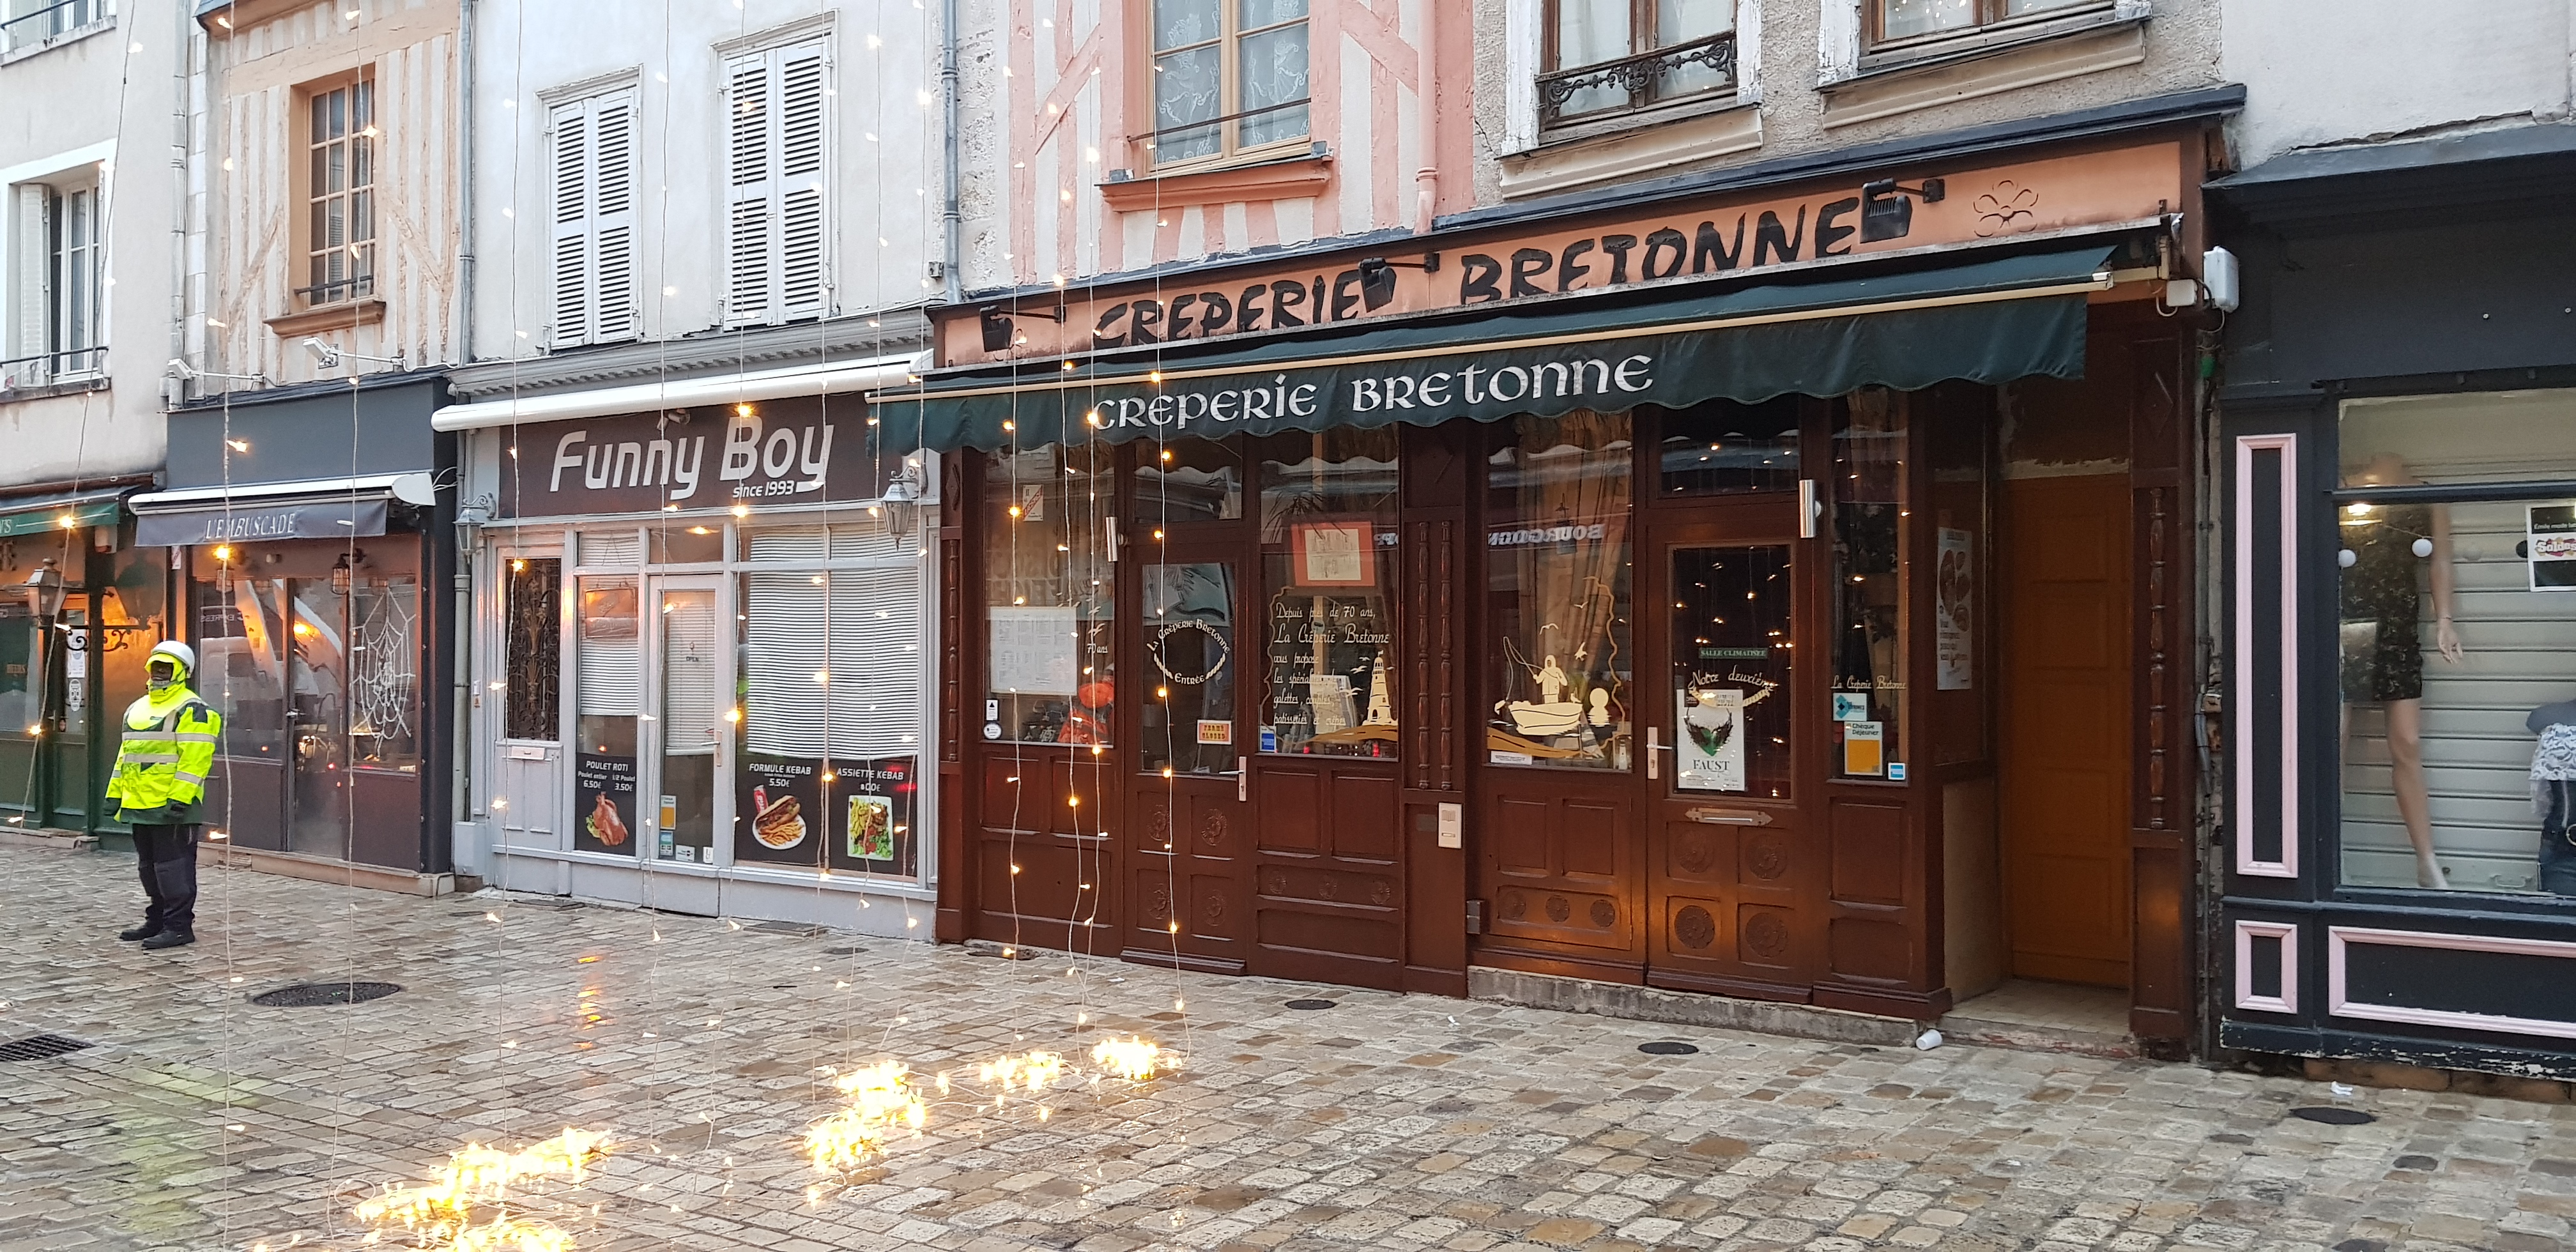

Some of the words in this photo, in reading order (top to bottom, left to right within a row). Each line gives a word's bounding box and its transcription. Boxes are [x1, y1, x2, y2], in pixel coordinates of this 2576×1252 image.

[1093, 270, 1361, 349] CREPERIE
[1461, 197, 1859, 305] BRETONNE
[549, 430, 705, 500] Funny
[719, 415, 834, 493] Boy
[733, 482, 762, 498] since
[765, 480, 795, 496] 1993
[204, 513, 296, 539] L'EMBUSCADE
[1276, 602, 1303, 623] Depuis
[1329, 601, 1339, 618] de
[1344, 606, 1355, 618] 70
[1273, 623, 1291, 643] La
[1344, 623, 1390, 644] Bretonne
[1688, 669, 1719, 690] Notre
[1830, 675, 1844, 689] La
[586, 760, 611, 770] POULET
[613, 763, 629, 772] ROTI
[749, 763, 785, 774] FORMULE
[786, 765, 811, 775] KEBAB
[1693, 759, 1730, 770] FAUST
[769, 778, 790, 788] 5.50€
[836, 768, 875, 778] ASSIETTE
[877, 770, 904, 781] KEBAB
